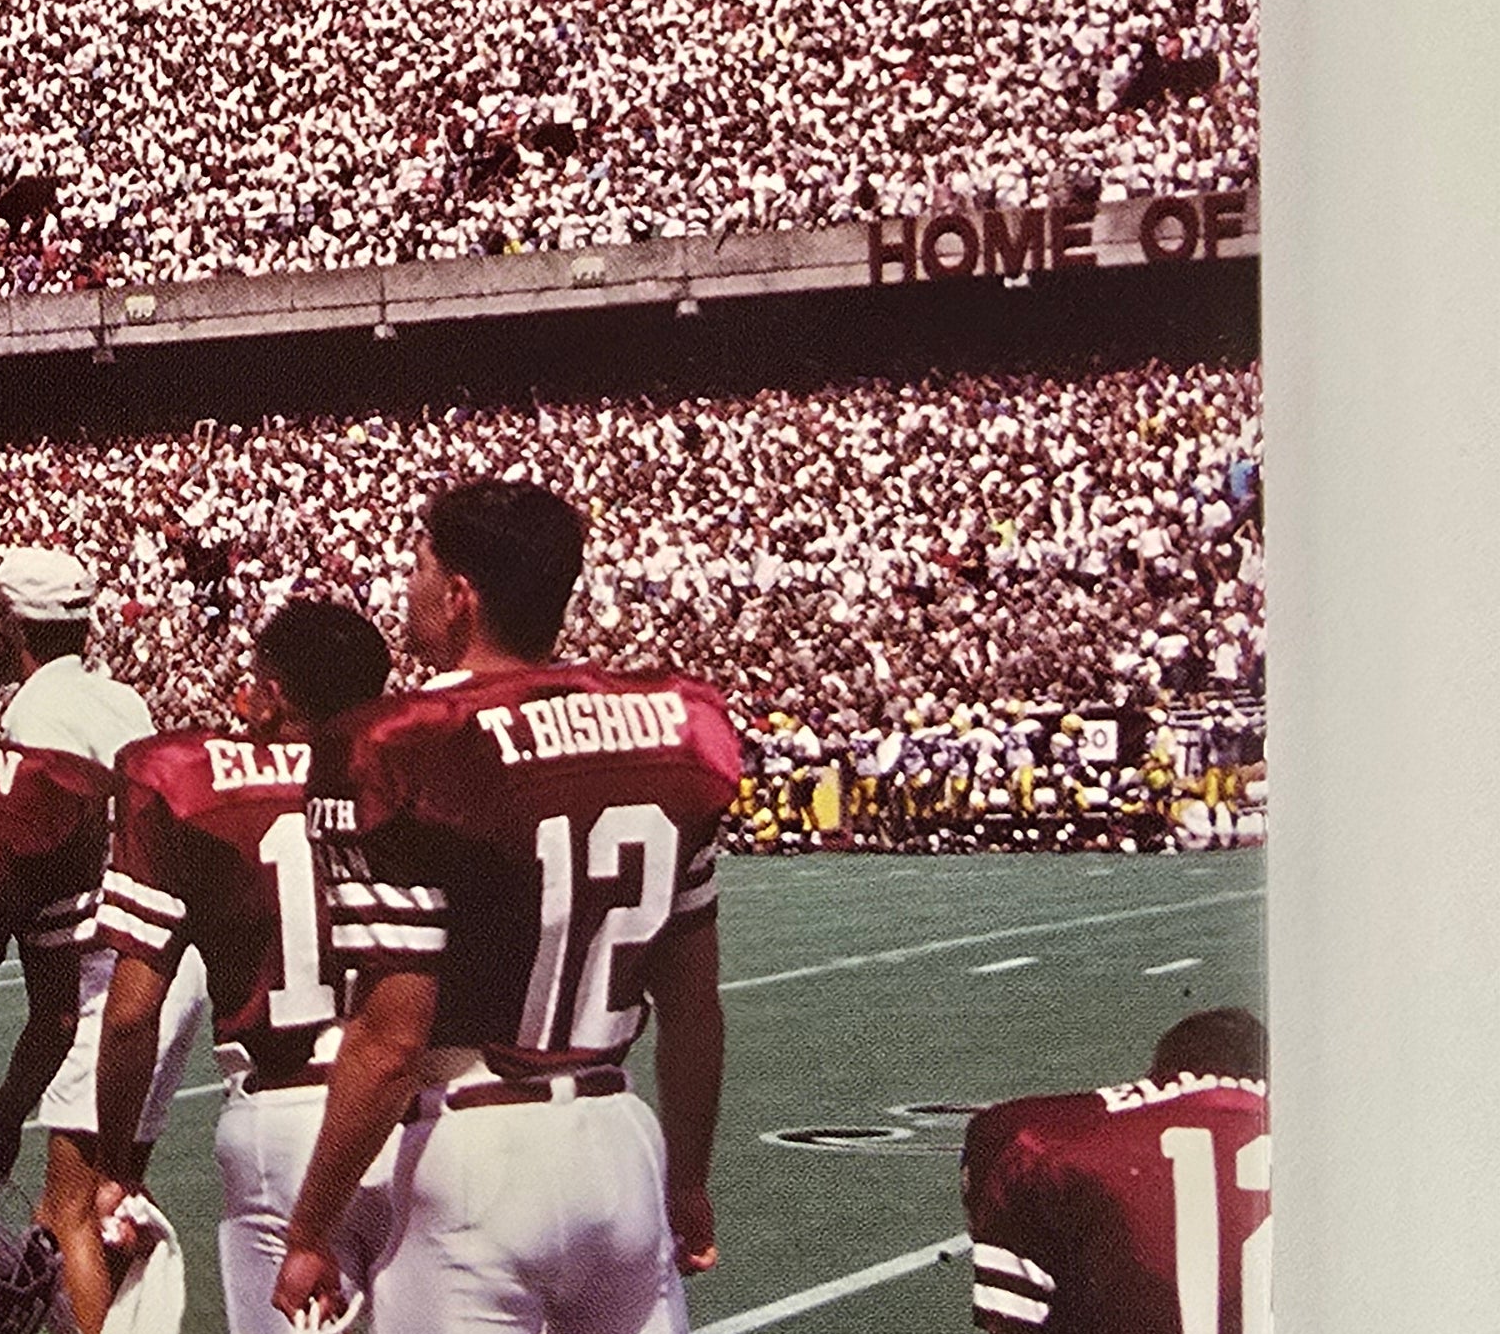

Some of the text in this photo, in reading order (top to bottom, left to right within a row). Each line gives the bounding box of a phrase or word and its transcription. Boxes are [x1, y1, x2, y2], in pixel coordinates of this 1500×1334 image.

[868, 192, 1248, 285] HOME OF
[258, 811, 340, 1029] 1
[517, 803, 678, 1051] 12
